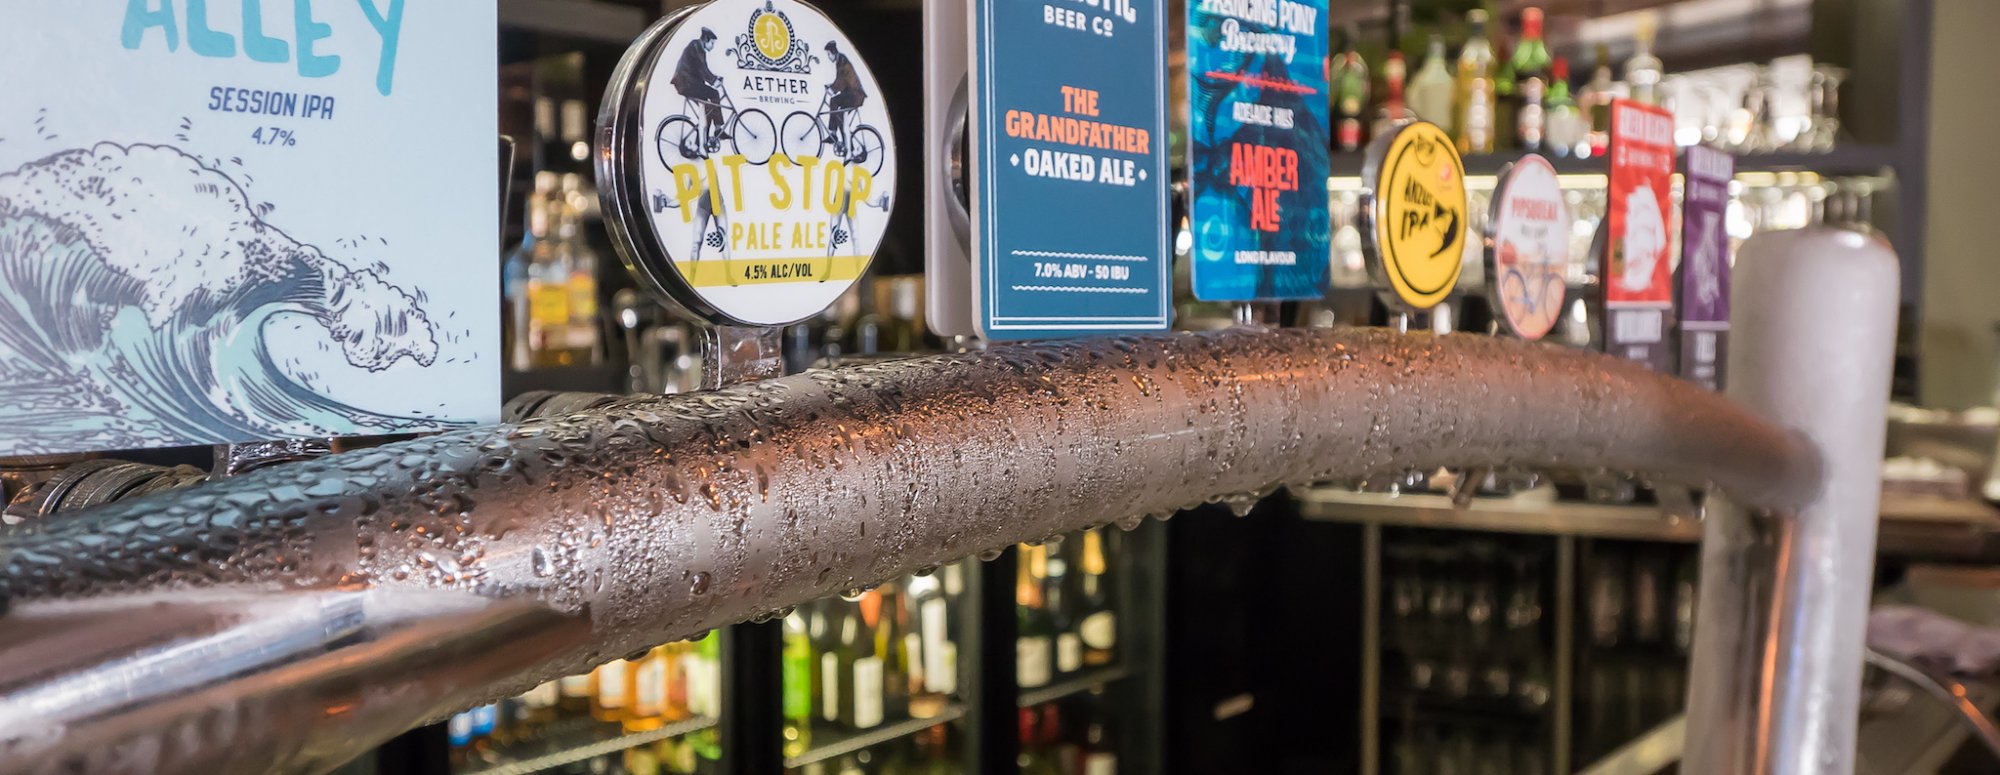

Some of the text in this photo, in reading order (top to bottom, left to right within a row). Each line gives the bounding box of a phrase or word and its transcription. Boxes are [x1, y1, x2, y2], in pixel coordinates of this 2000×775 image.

[1043, 4, 1087, 31] BEER
[1280, 0, 1317, 36] PONY
[120, 0, 404, 96] ALLEY
[743, 75, 809, 94] AETHER
[759, 95, 796, 105] BREWING
[208, 86, 335, 120] SESSION IPA
[1060, 85, 1100, 117] THE
[251, 127, 296, 146] 4.7%
[1005, 109, 1150, 155] GRANDFATHER
[1024, 148, 1136, 187] OAKED ALE
[1230, 142, 1299, 192] AMBER
[673, 152, 873, 224] PIT STOP
[1251, 187, 1280, 232] ALE
[1401, 208, 1429, 241] IPA
[732, 221, 827, 251] PALE ALE
[744, 262, 813, 280] 4.5% ALC/VOL
[1034, 262, 1063, 279] 7.0%
[1064, 263, 1087, 279] ABV
[1095, 265, 1110, 279] 50
[1111, 265, 1131, 281] IBU
[1259, 251, 1297, 266] FLAVOUR
